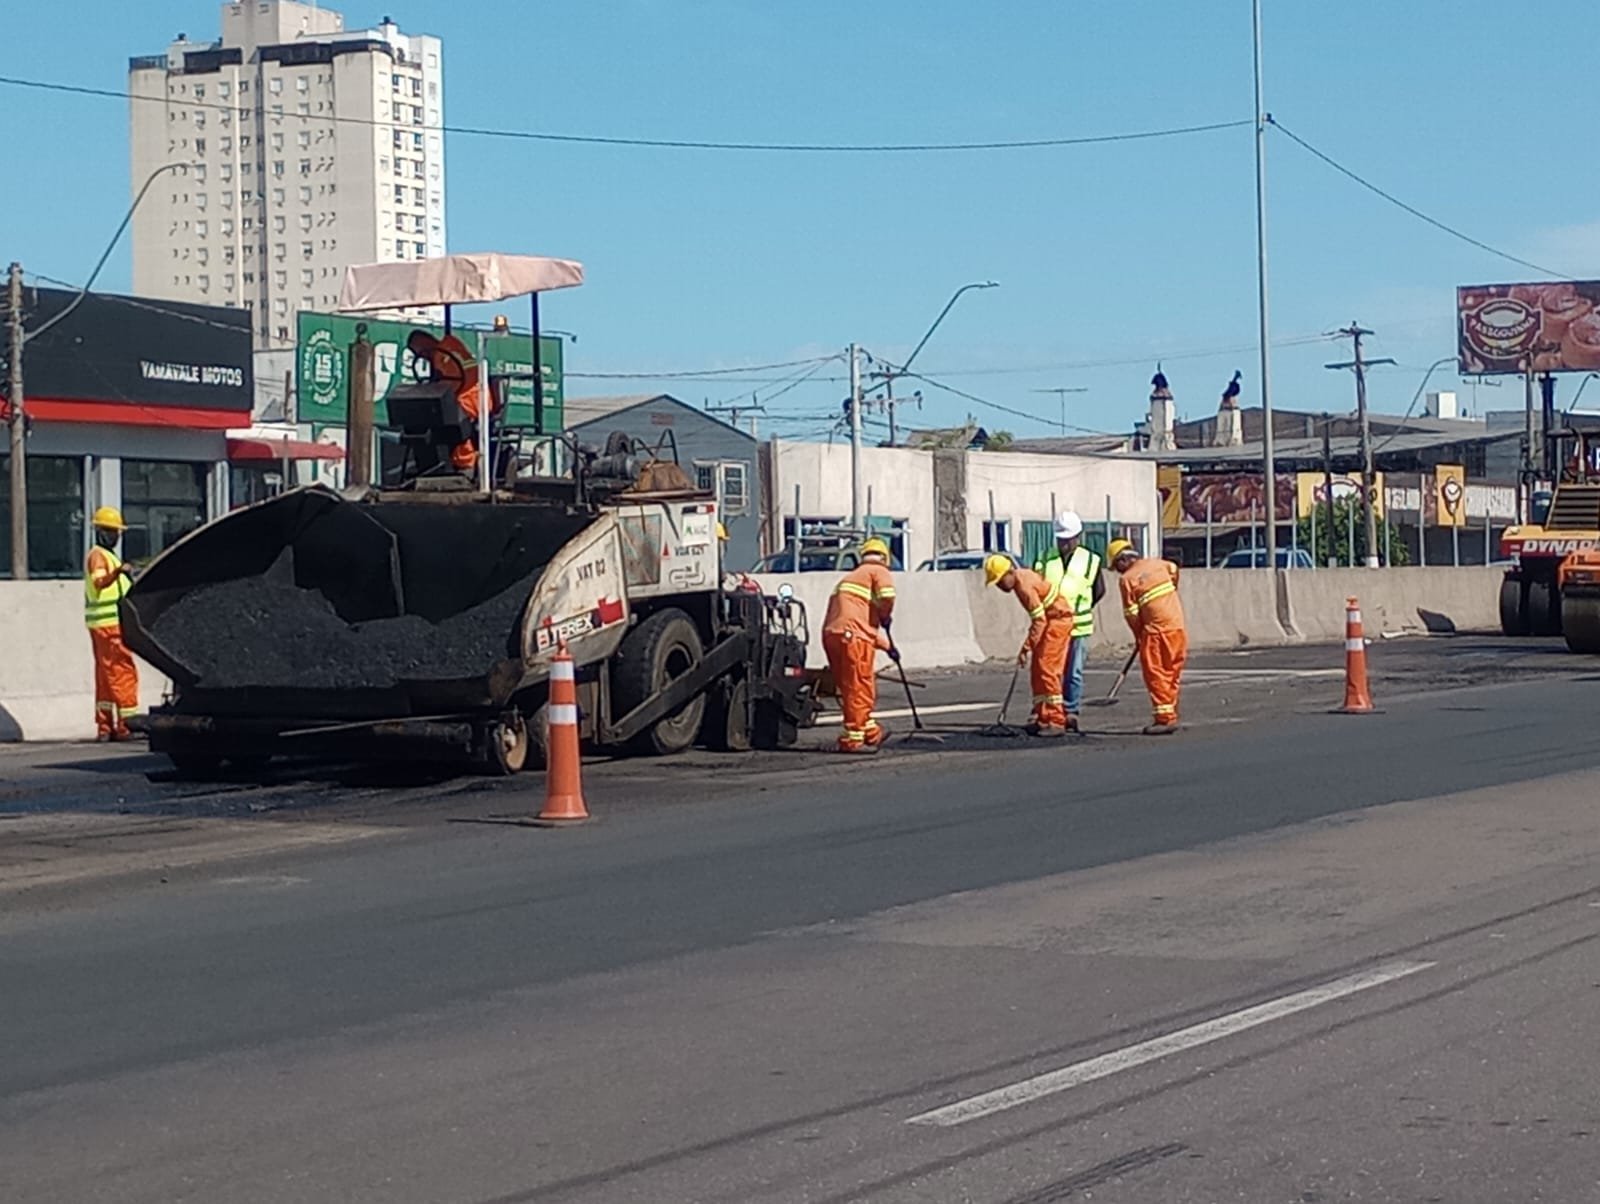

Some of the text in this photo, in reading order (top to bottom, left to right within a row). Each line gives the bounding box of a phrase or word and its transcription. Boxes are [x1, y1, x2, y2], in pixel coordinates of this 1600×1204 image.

[140, 360, 243, 386] YAMAVALE MOTOS
[551, 612, 593, 646] TEREX
